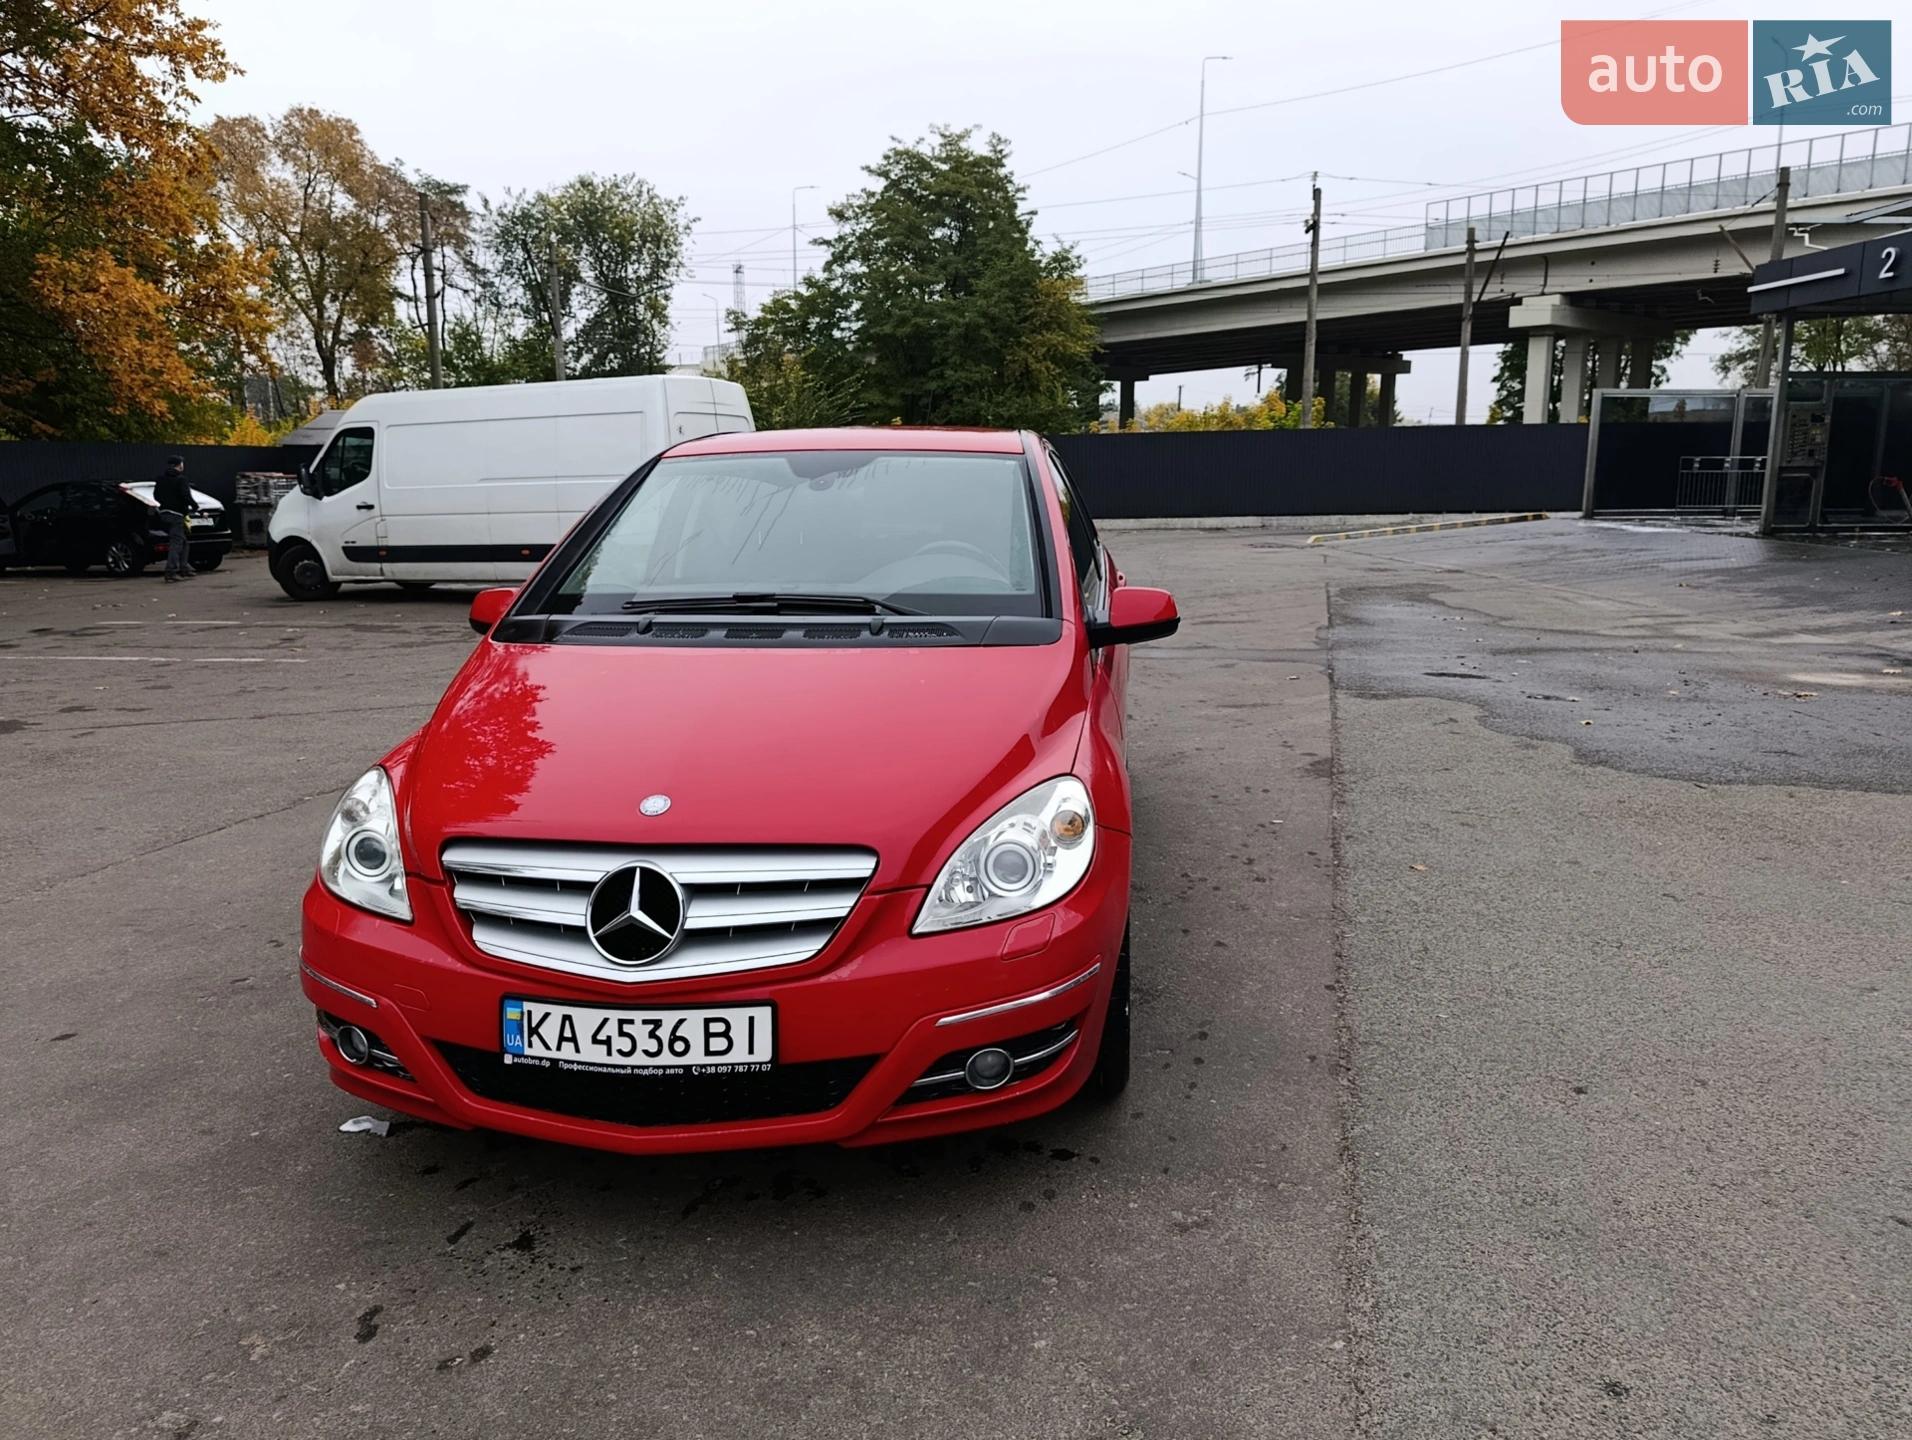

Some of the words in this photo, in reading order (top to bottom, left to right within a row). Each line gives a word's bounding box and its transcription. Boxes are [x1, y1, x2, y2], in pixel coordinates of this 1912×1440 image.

[1878, 246, 1897, 279] 2
[526, 1009, 581, 1054] KA
[591, 1017, 691, 1058] 4536
[703, 1015, 755, 1057] BI
[506, 1034, 523, 1048] UA
[513, 1056, 551, 1068] autobro.dp
[558, 1061, 632, 1075] Профессиональный
[633, 1066, 664, 1076] подбор
[701, 1066, 716, 1074] +38
[717, 1065, 732, 1074] 097
[734, 1065, 748, 1073] 787
[750, 1064, 760, 1072] 77
[761, 1064, 772, 1072] 07
